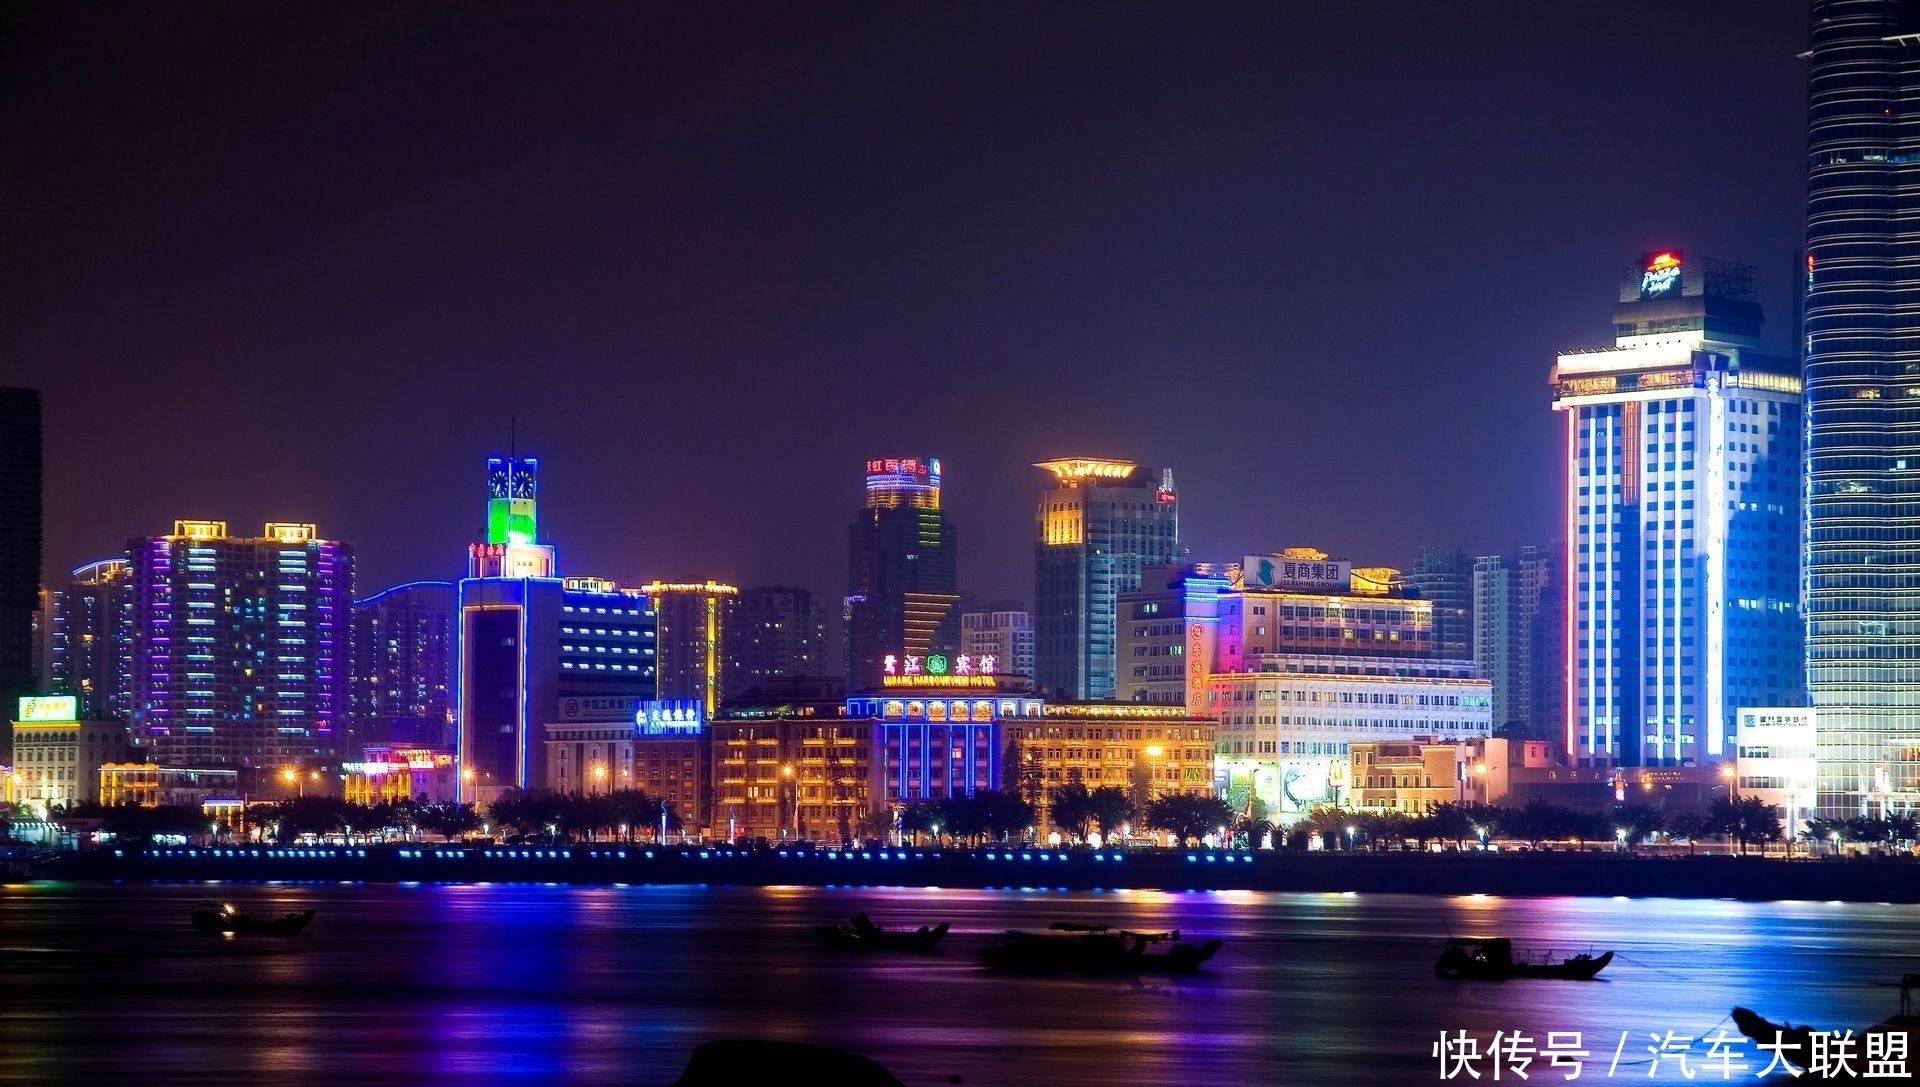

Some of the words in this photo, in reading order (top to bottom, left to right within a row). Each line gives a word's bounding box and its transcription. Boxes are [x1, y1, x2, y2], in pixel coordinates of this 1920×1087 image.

[1283, 562, 1339, 580] 夏商集团
[1283, 580, 1315, 588] SEASHINE
[1192, 643, 1203, 707] 东海酒店
[969, 676, 997, 687] HOTEL
[582, 699, 633, 710] 中国工商银行
